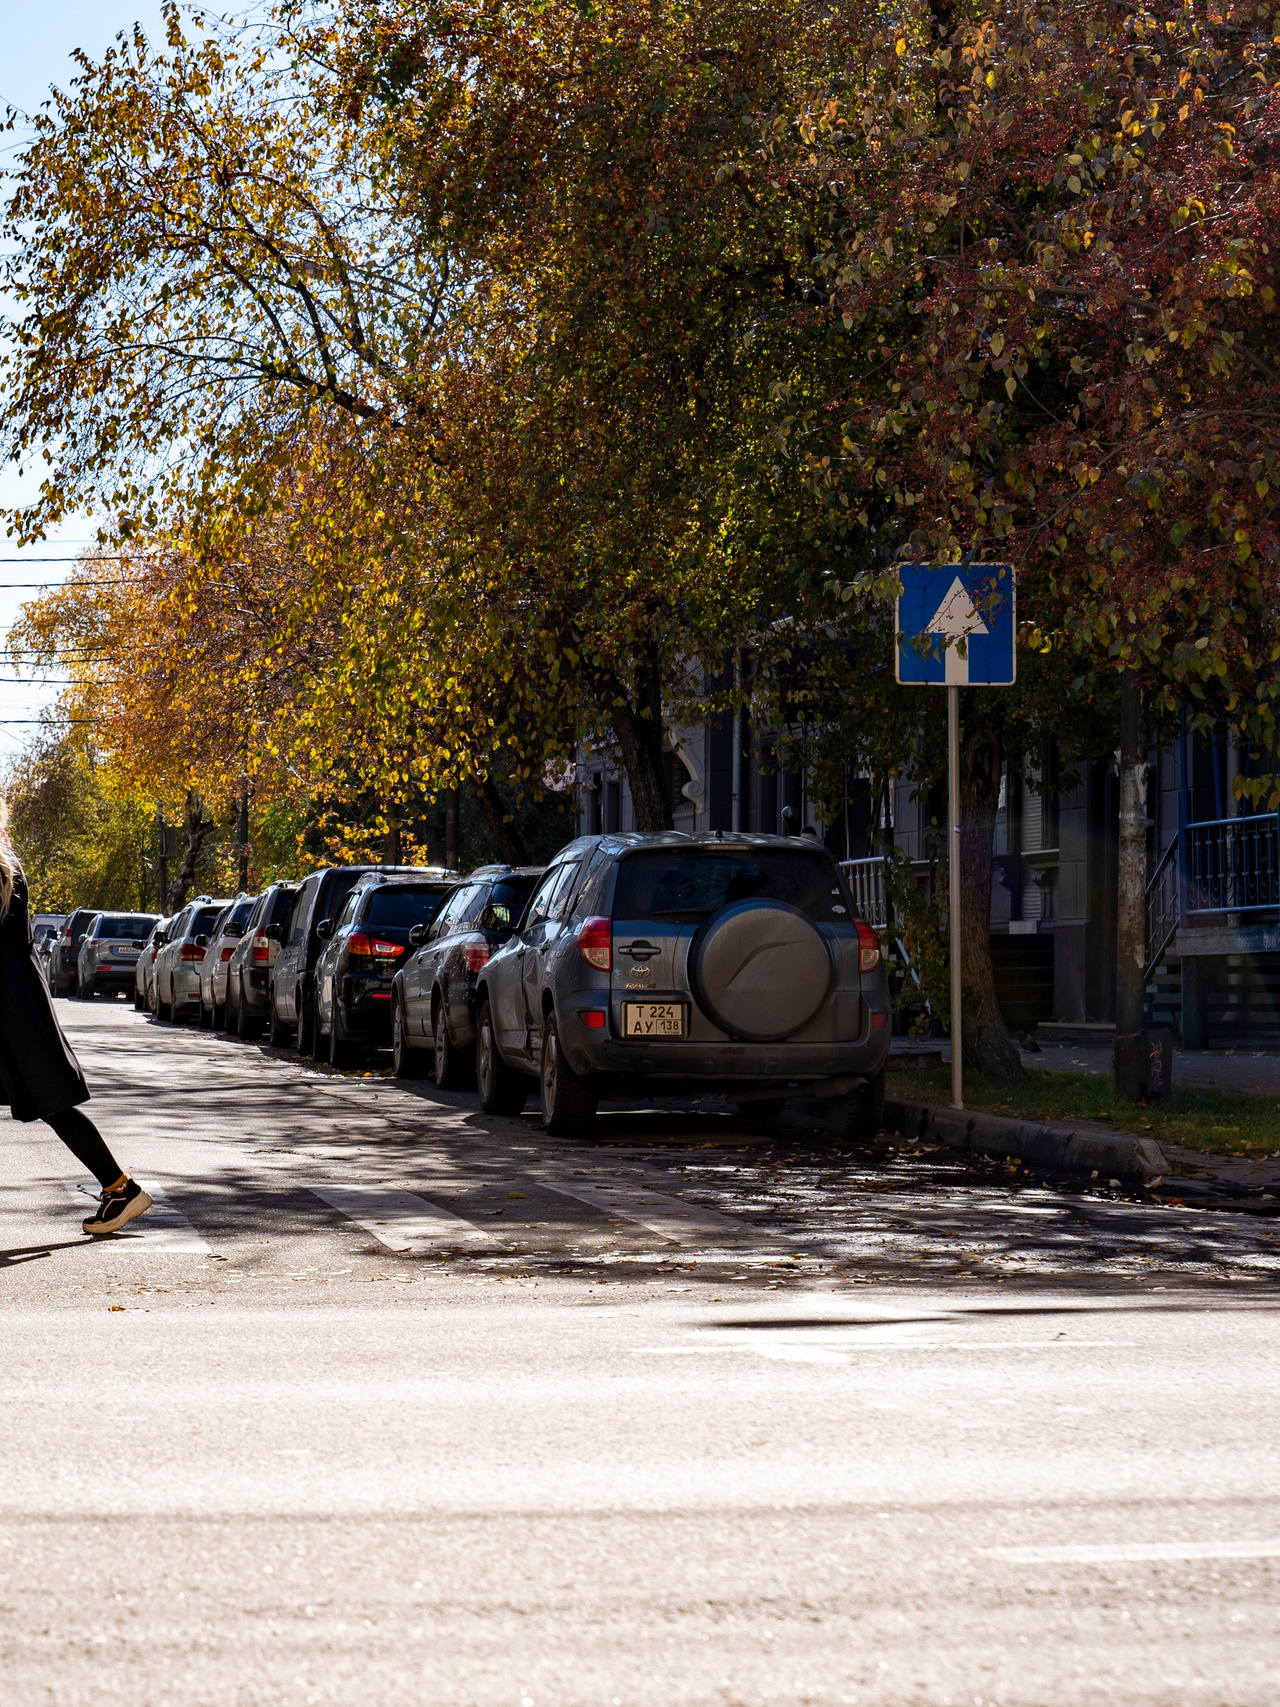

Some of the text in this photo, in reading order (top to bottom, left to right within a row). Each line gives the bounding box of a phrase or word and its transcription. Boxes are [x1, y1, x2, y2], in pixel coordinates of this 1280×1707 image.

[636, 1006, 673, 1018] Т 224
[633, 1021, 679, 1033] АУ 138
